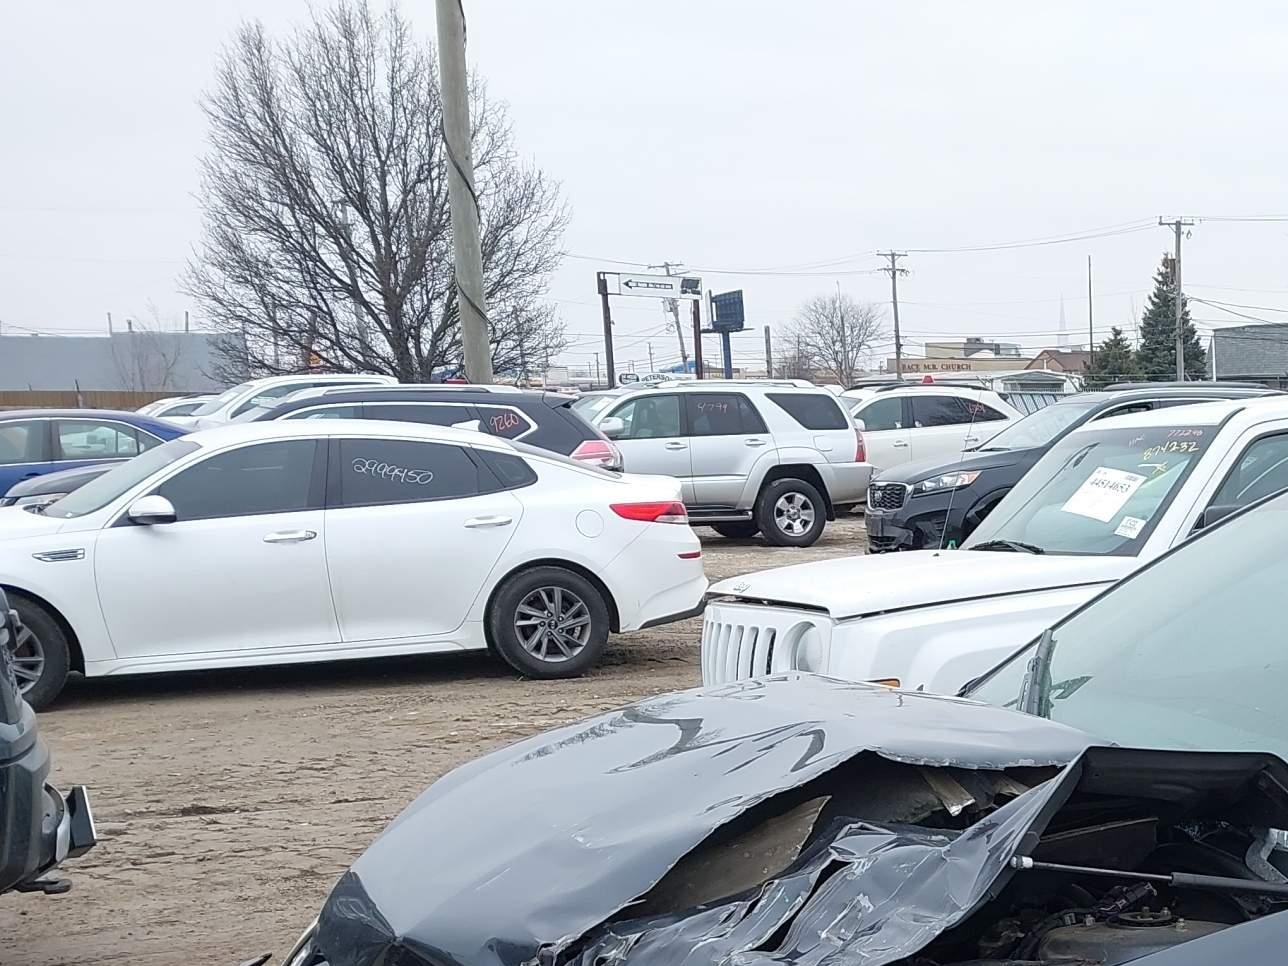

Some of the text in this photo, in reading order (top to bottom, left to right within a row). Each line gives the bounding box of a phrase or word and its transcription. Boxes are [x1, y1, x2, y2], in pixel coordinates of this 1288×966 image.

[940, 363, 972, 371] CHURCH
[490, 412, 519, 433] 9260
[1143, 440, 1200, 461] 874232
